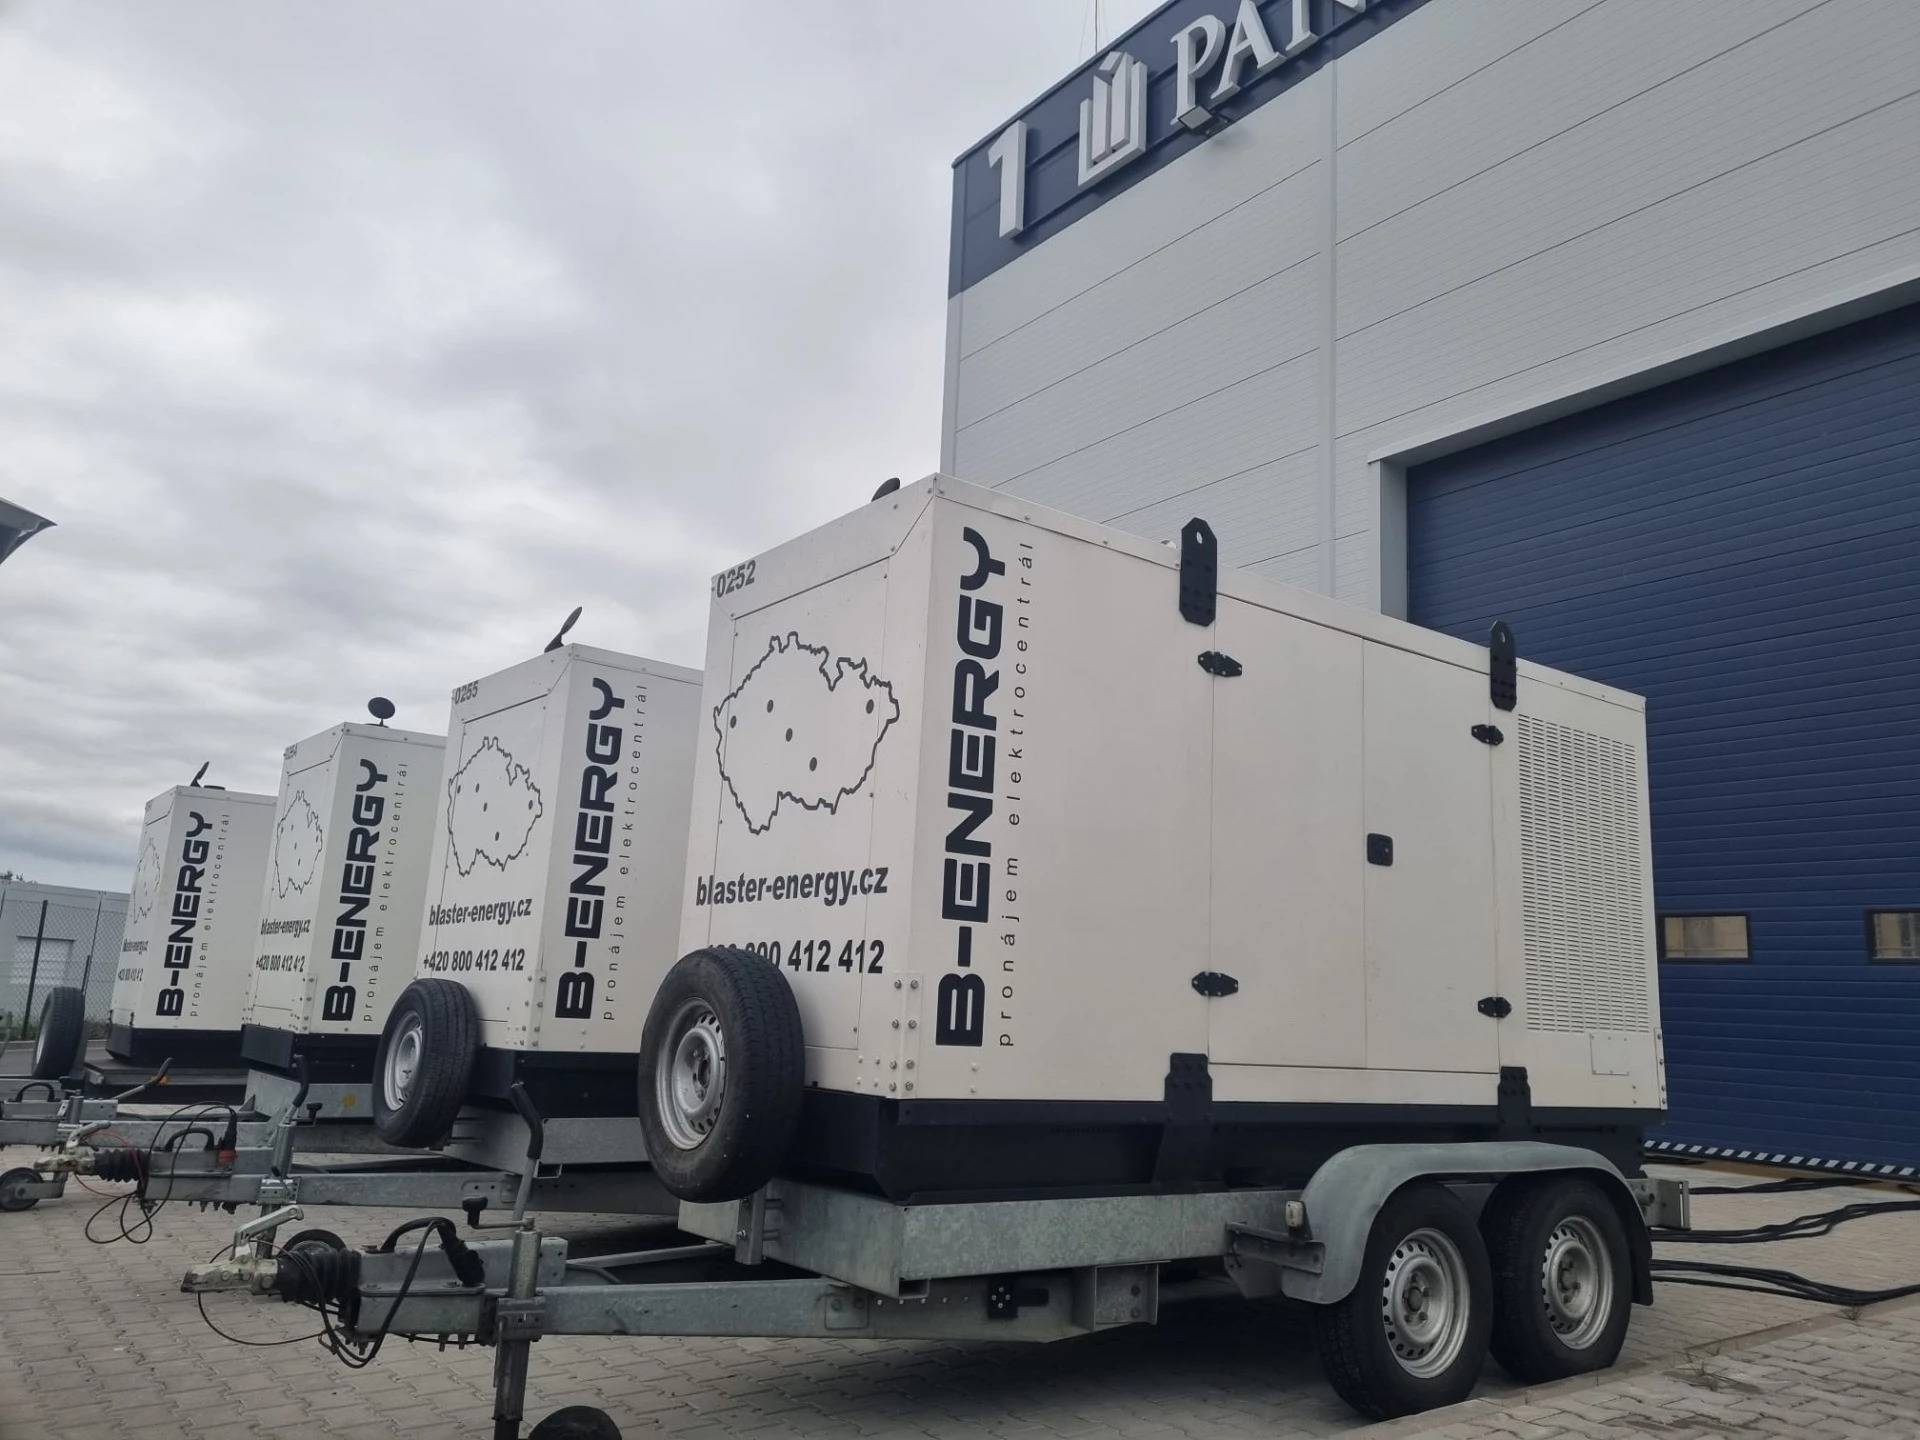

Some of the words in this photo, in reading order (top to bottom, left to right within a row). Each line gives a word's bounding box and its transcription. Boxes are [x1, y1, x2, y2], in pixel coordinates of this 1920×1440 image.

[717, 560, 756, 598] 0252
[935, 526, 1006, 1047] B-ENERGY
[1007, 542, 1034, 827] elektrocentrál
[156, 811, 213, 1017] B-ENERGY
[321, 758, 388, 1022] B-ENERGY
[363, 926, 385, 1022] pronájem
[379, 763, 409, 912] elektrocentrál
[428, 898, 532, 926] blaster-energy.cz
[555, 677, 626, 1020] B-ENERGY
[602, 895, 627, 1021] pronájem
[618, 685, 648, 876] elektrocentrál
[696, 867, 889, 907] blaster-energy.cz
[423, 950, 449, 972] +420
[451, 950, 473, 972] 800
[475, 949, 499, 972] 412
[501, 948, 526, 972] 412
[788, 939, 832, 973] 412
[838, 939, 885, 974] 412
[999, 856, 1021, 1048] pronájem
